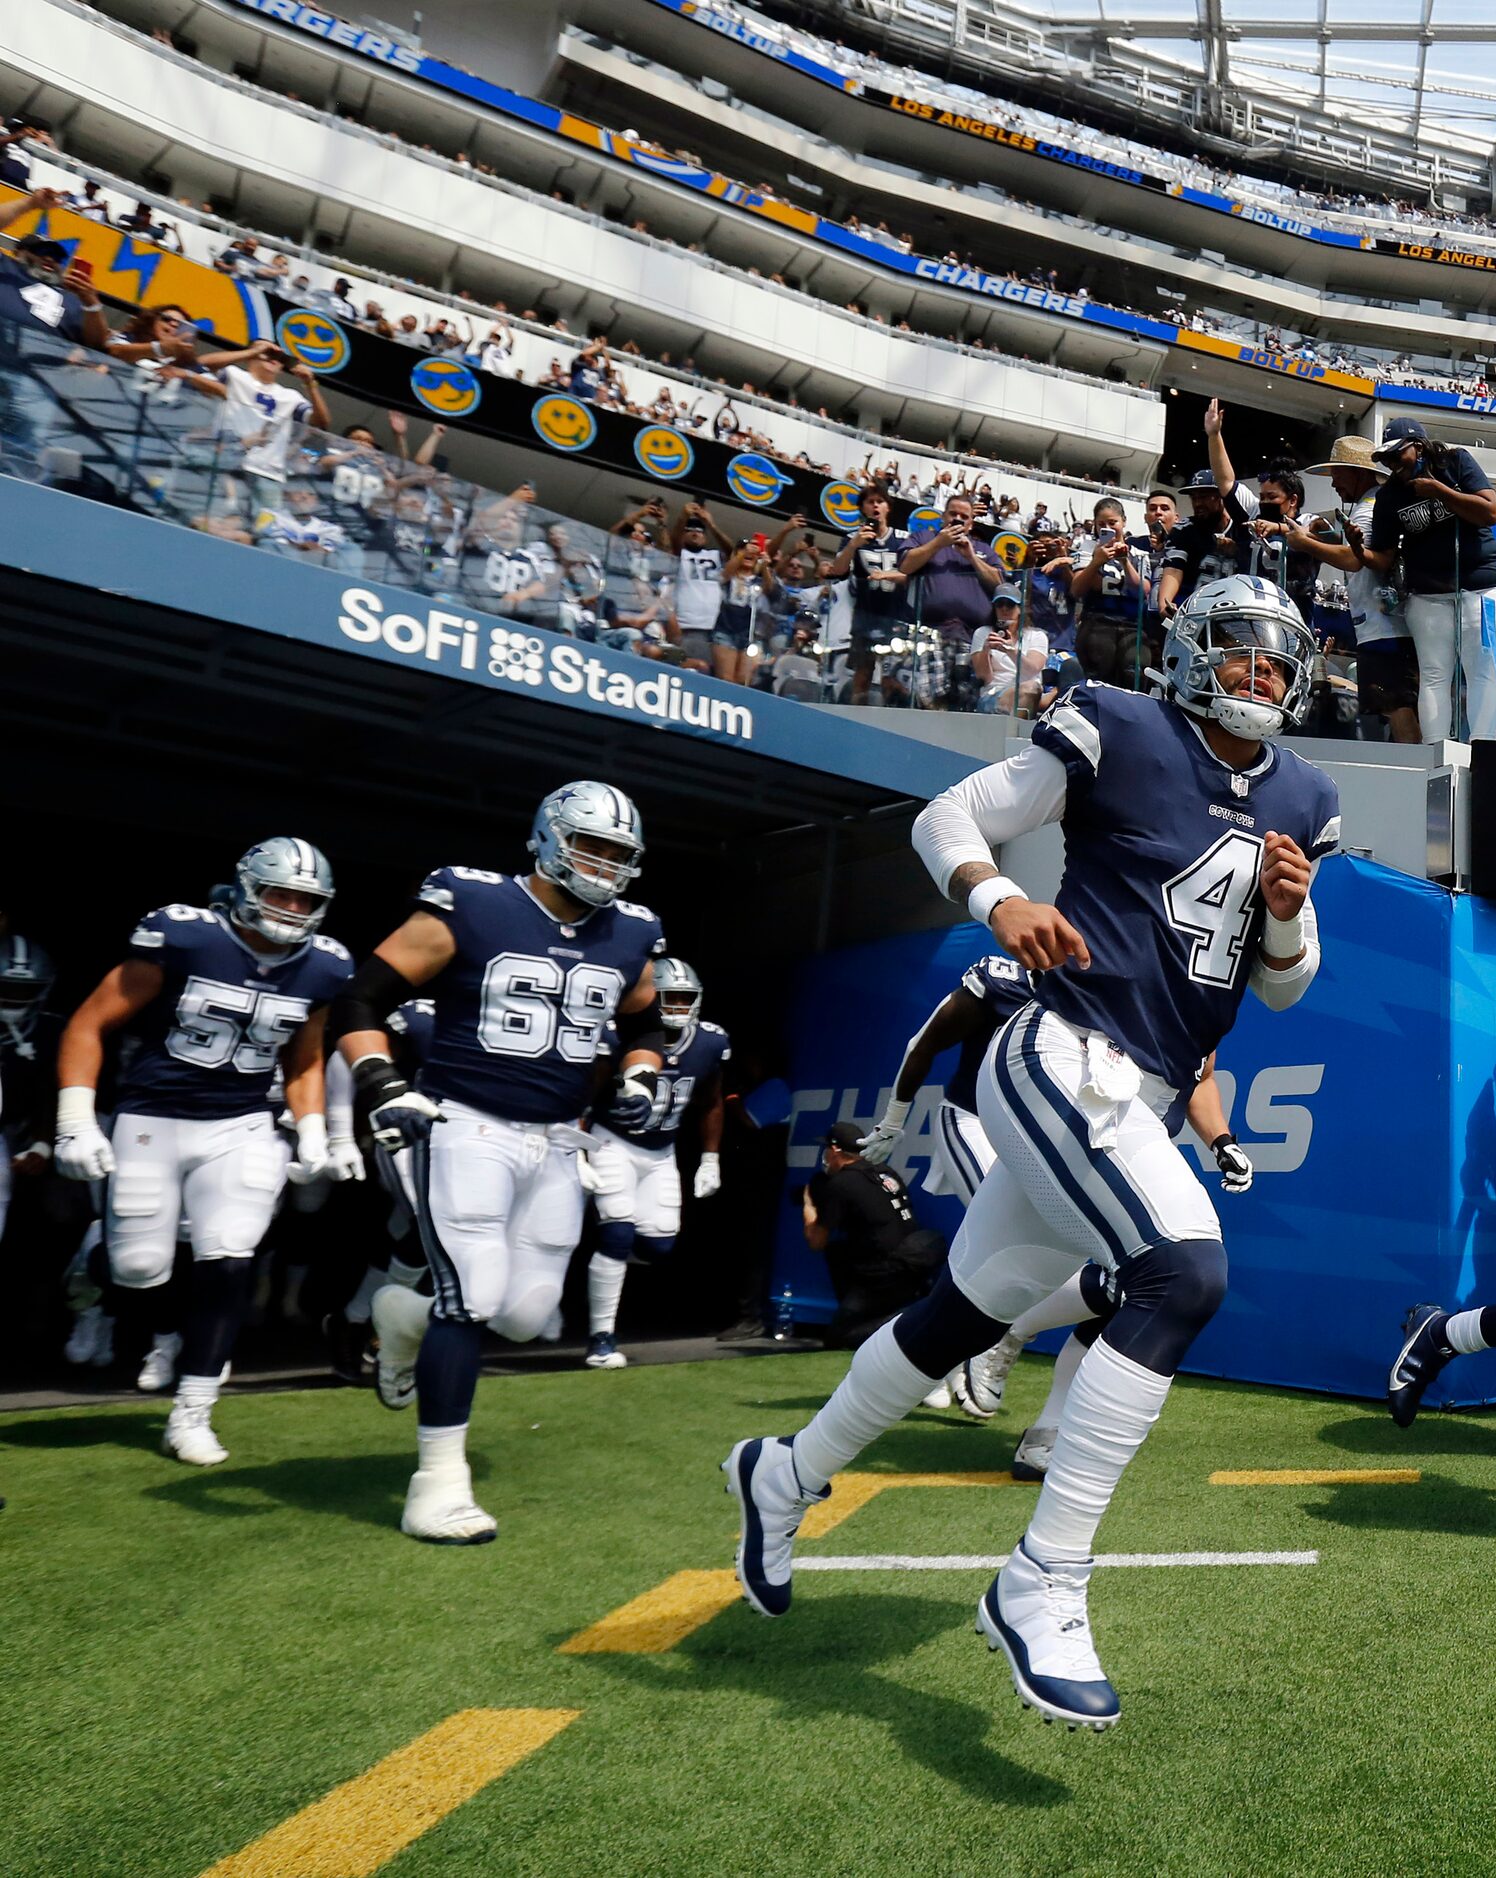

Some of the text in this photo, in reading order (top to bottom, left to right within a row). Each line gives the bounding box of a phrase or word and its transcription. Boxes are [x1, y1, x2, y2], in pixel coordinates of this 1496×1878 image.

[890, 96, 1143, 184] LOS ANGELES CHARGERS
[1231, 203, 1312, 236] #BOLTUP
[1398, 243, 1433, 258] LOS
[915, 259, 1087, 317] CHARGERS
[1239, 346, 1325, 380] BOLT UP
[337, 587, 752, 740] SoFi Stadium
[1209, 804, 1255, 827] COWBOYS
[1161, 828, 1266, 990] 4
[165, 975, 314, 1074] 55
[477, 952, 625, 1063] 69
